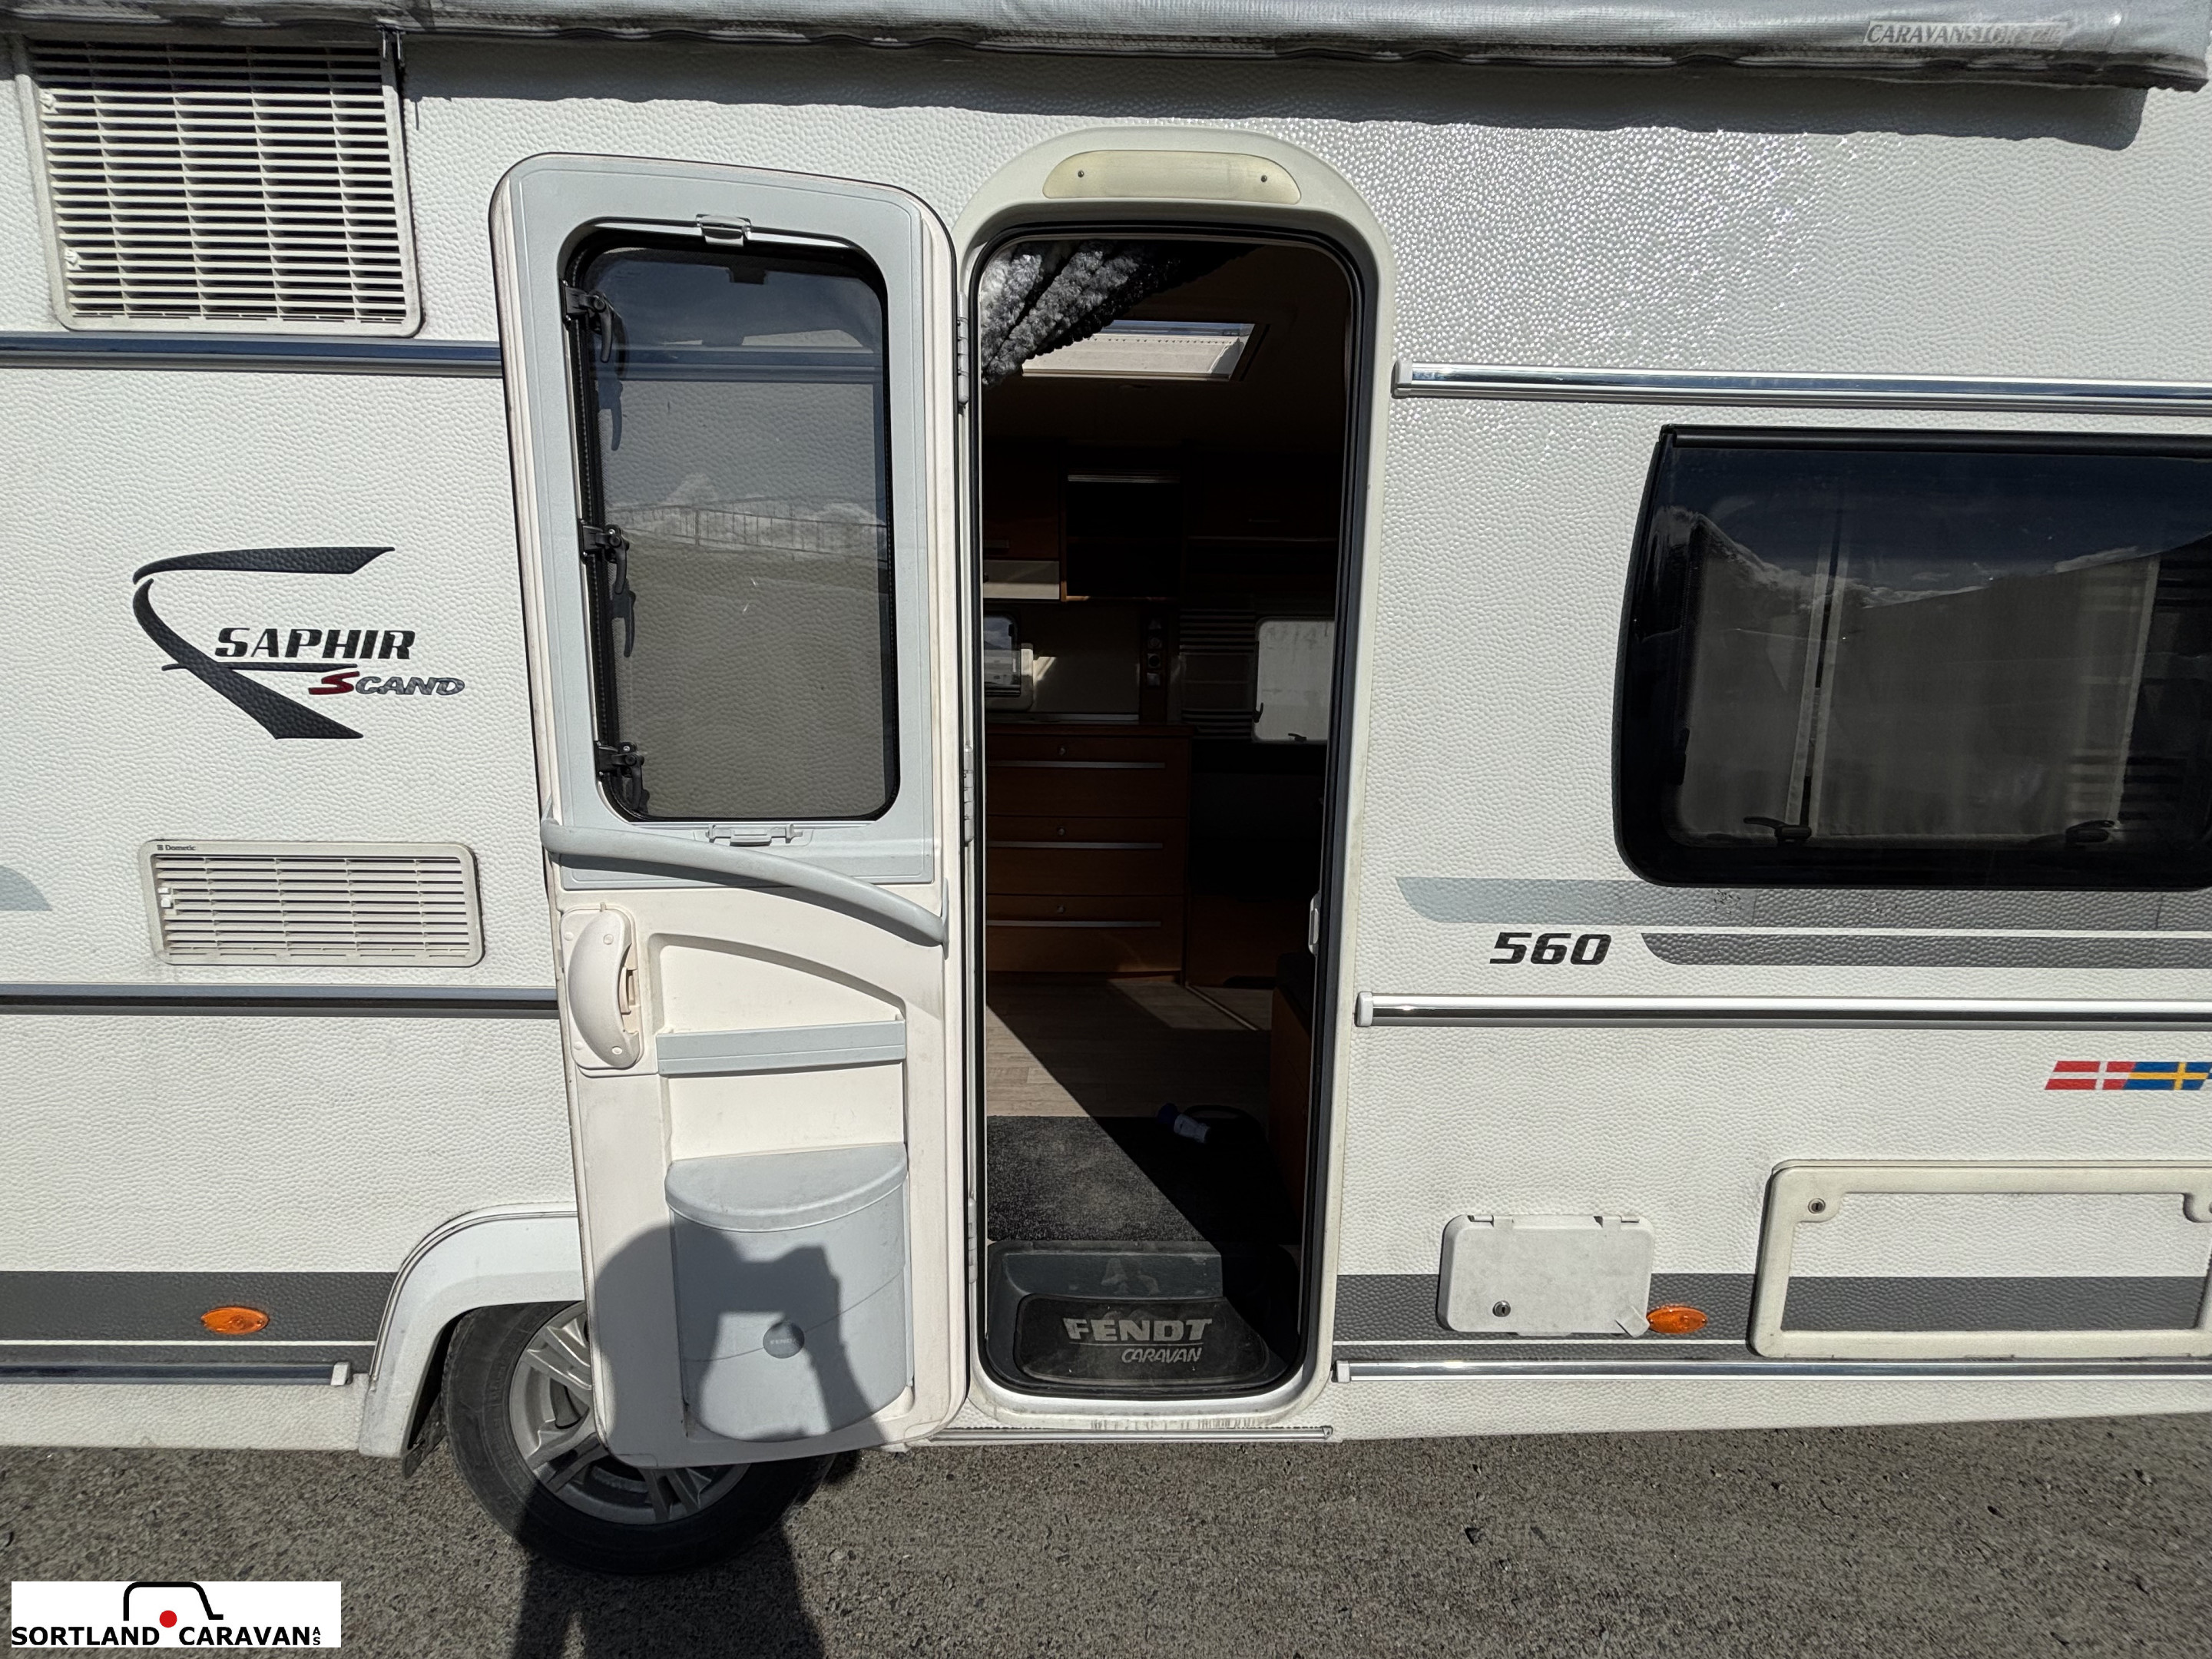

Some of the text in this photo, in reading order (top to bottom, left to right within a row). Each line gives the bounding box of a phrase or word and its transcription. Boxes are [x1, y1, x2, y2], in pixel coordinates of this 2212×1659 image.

[214, 628, 416, 659] SAPHIR
[308, 671, 465, 695] SCAND
[1489, 932, 1611, 965] 560
[1063, 1318, 1212, 1341] FENDT
[1121, 1347, 1202, 1363] CARAVAN
